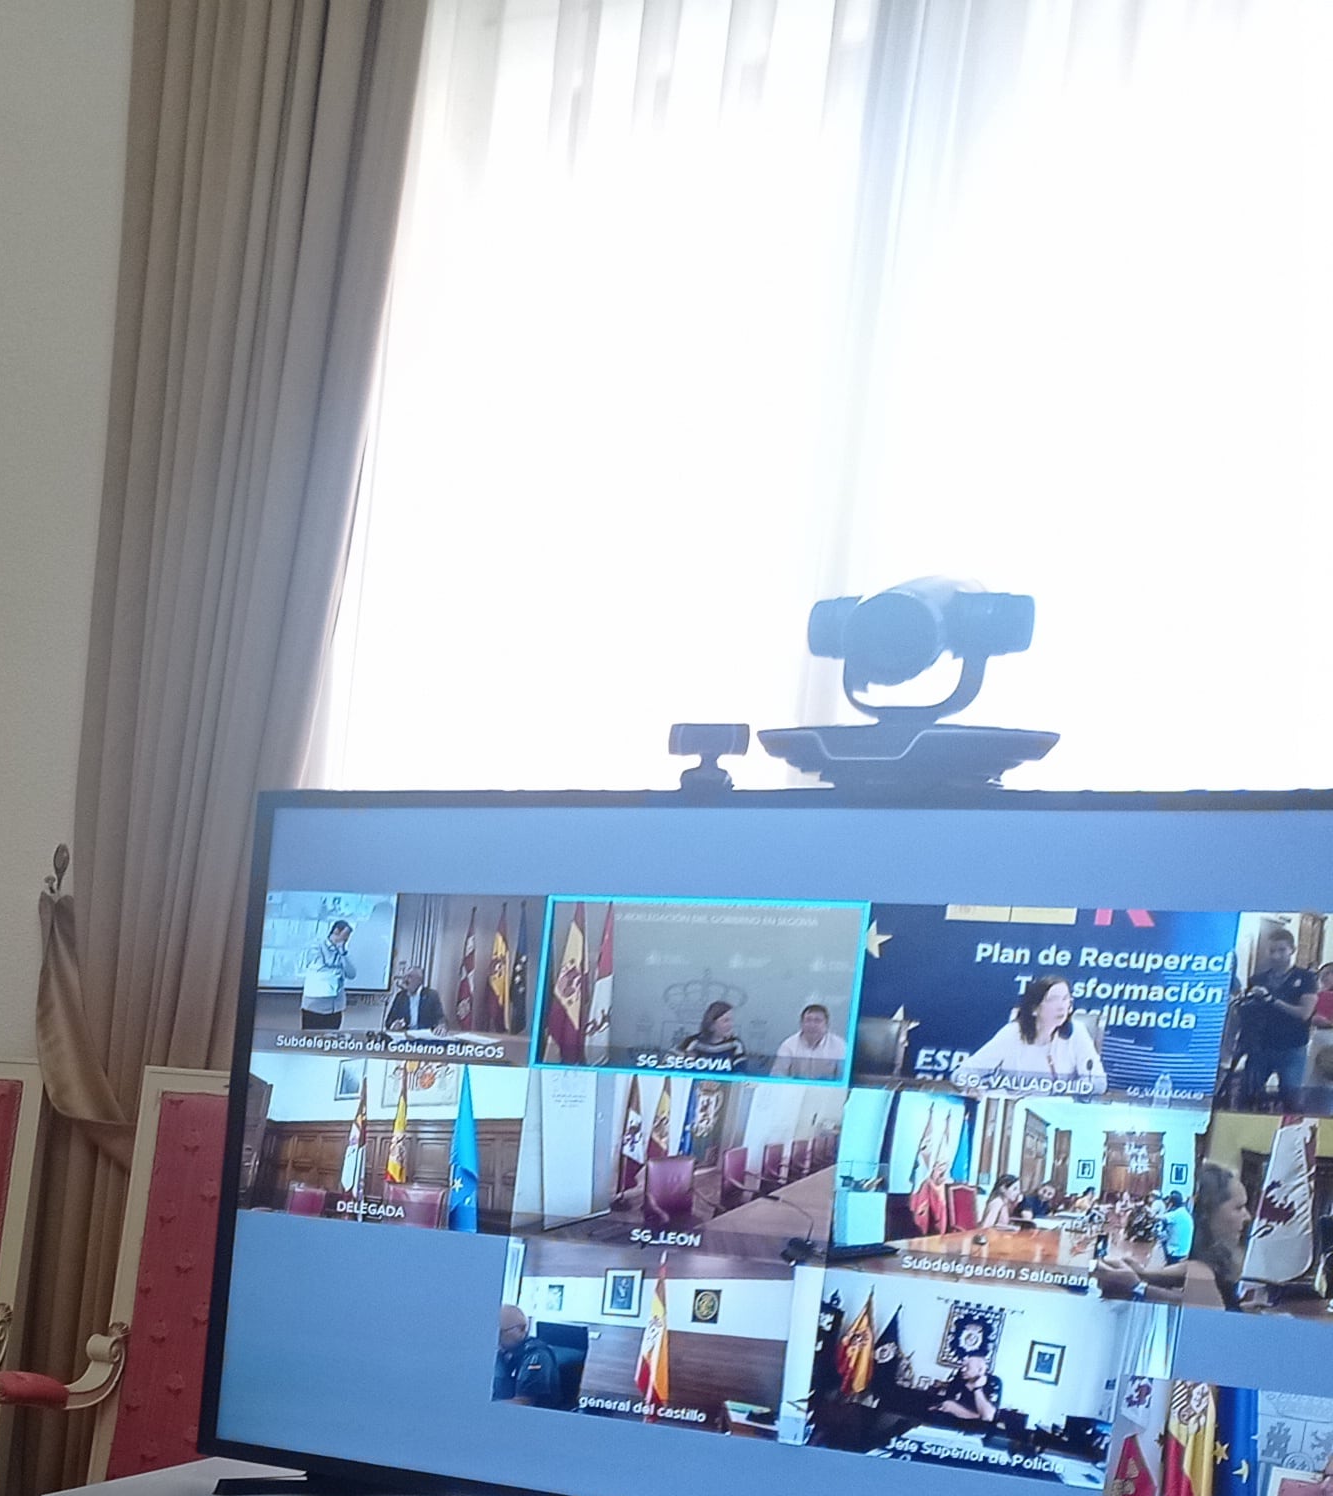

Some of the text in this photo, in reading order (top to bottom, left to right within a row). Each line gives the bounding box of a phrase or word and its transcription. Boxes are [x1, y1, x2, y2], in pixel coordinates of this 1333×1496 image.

[975, 943, 1031, 966] Plan
[1037, 945, 1072, 966] de
[1014, 975, 1224, 1005] Tsformación
[275, 1034, 505, 1059] Subdelegación del Gobierno BURGOS
[635, 1053, 733, 1072] SG_SEGOVIA
[955, 1072, 1094, 1095] SG_VALLADOLID
[336, 1200, 405, 1218] DELEGADA
[629, 1228, 703, 1247] SG_LEON
[901, 1255, 1016, 1280] Subdelegación
[578, 1395, 707, 1423] general del castillo
